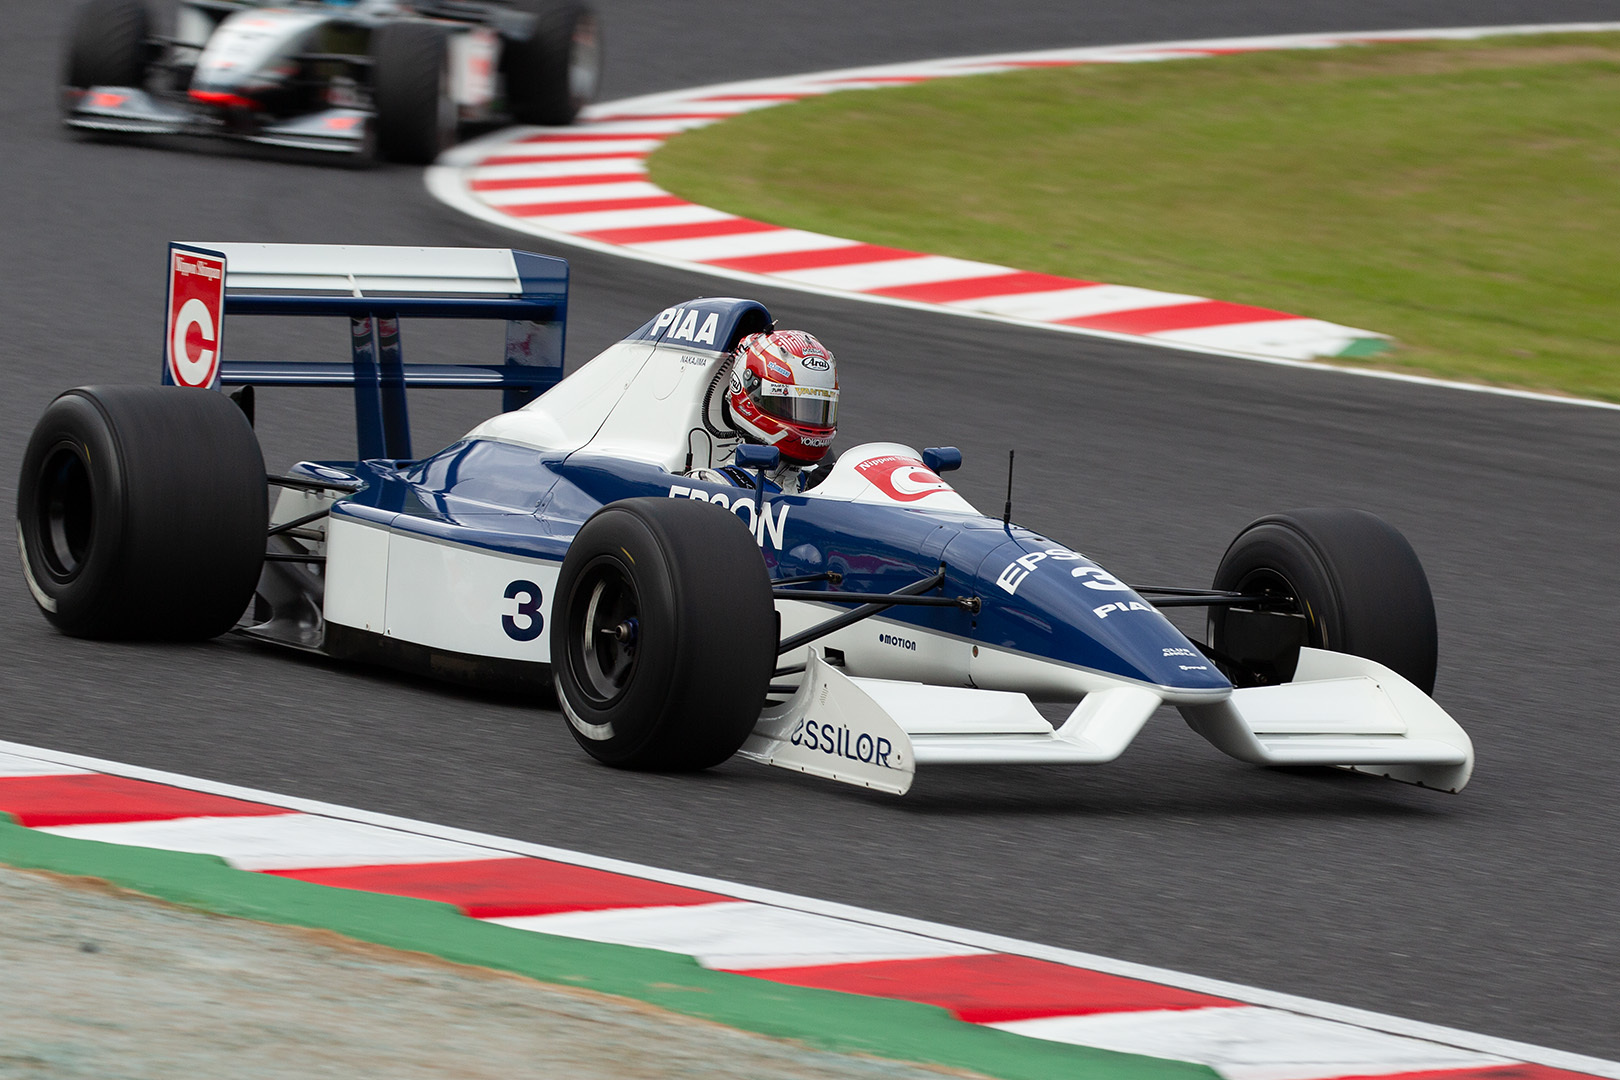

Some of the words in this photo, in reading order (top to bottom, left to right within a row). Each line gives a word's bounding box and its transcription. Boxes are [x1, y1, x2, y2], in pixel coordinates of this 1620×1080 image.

[174, 299, 215, 385] C
[650, 307, 720, 345] PIAA
[859, 456, 896, 471] Nippon
[1071, 566, 1131, 591] 3
[502, 580, 544, 642] 3
